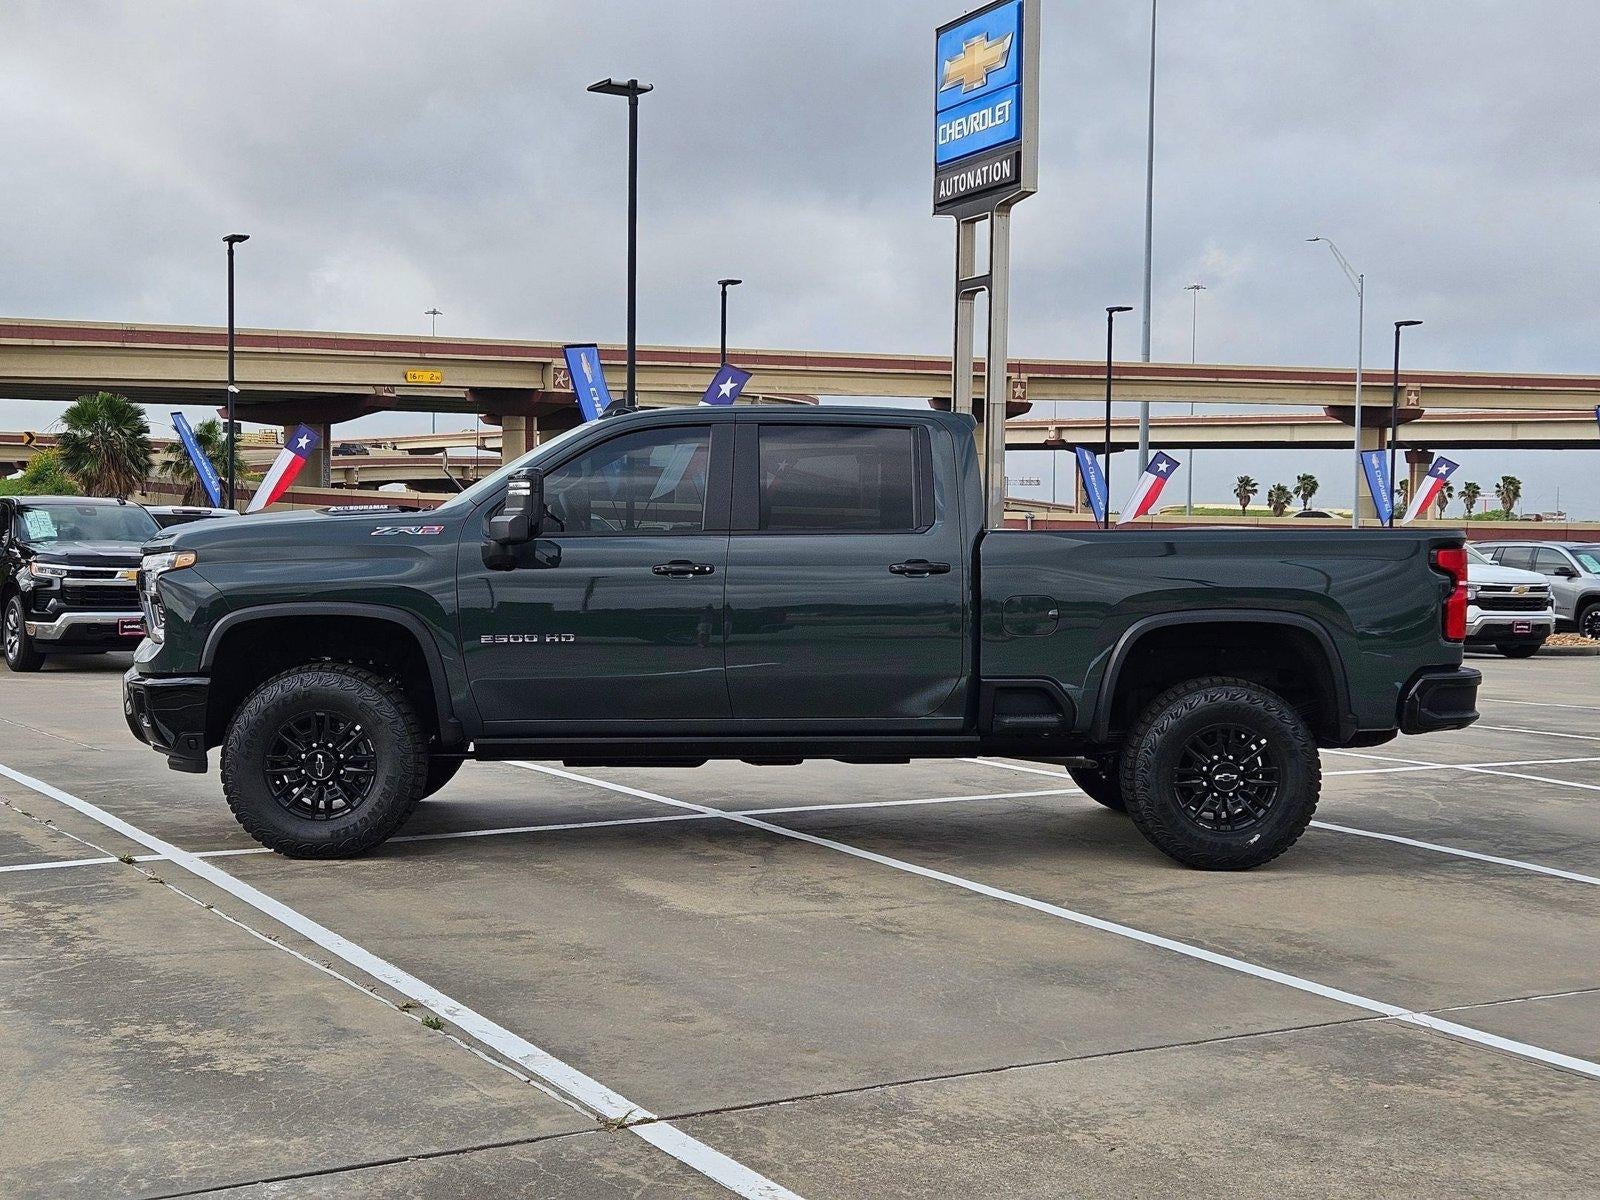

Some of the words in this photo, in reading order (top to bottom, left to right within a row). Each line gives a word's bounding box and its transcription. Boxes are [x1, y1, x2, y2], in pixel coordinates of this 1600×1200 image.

[938, 99, 1012, 146] CHEVROLET
[939, 158, 1011, 198] AUTONATION
[480, 634, 539, 644] 2500
[545, 633, 575, 643] HD
